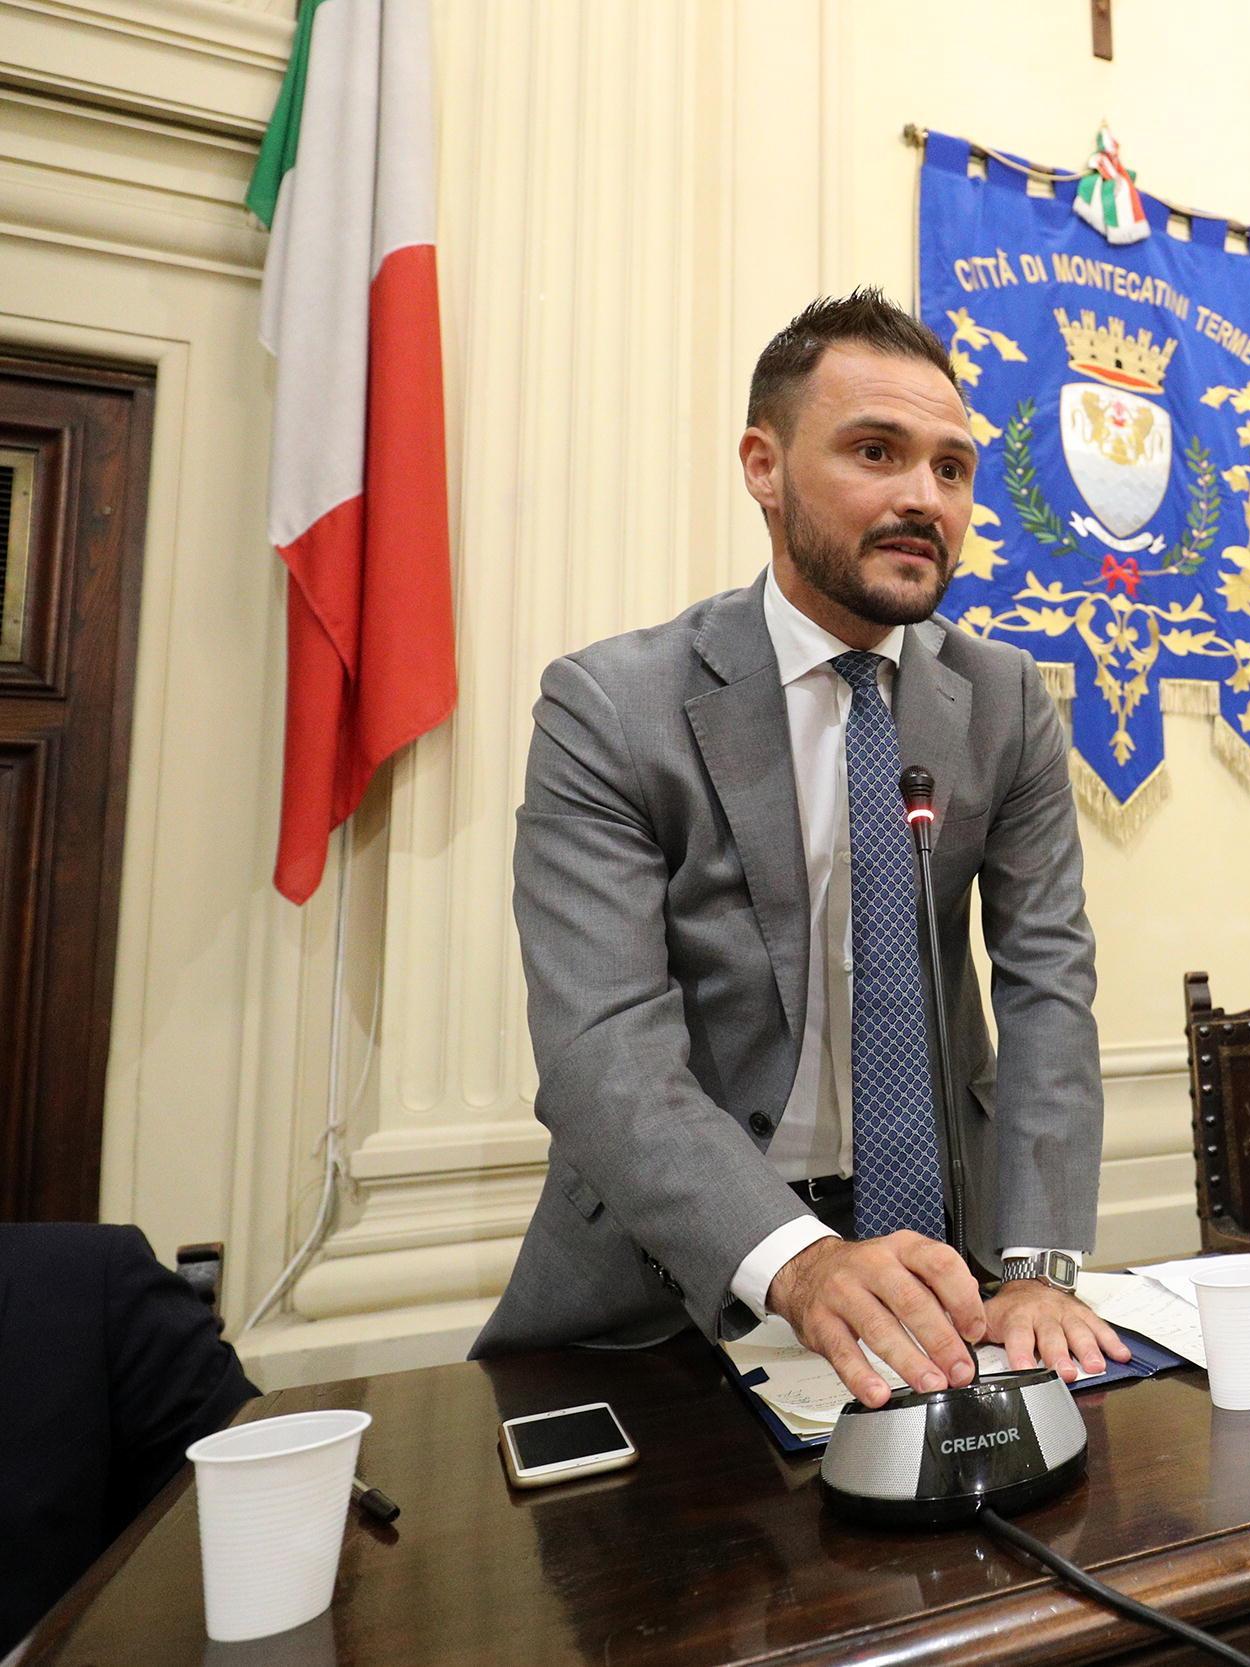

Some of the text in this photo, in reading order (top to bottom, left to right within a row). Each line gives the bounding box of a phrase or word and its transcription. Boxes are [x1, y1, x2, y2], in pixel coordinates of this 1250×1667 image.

[954, 247, 1018, 292] CITTÀ
[1019, 254, 1047, 284] DI
[1052, 252, 1190, 320] MONTECATINI
[940, 1427, 1020, 1455] CREATOR
